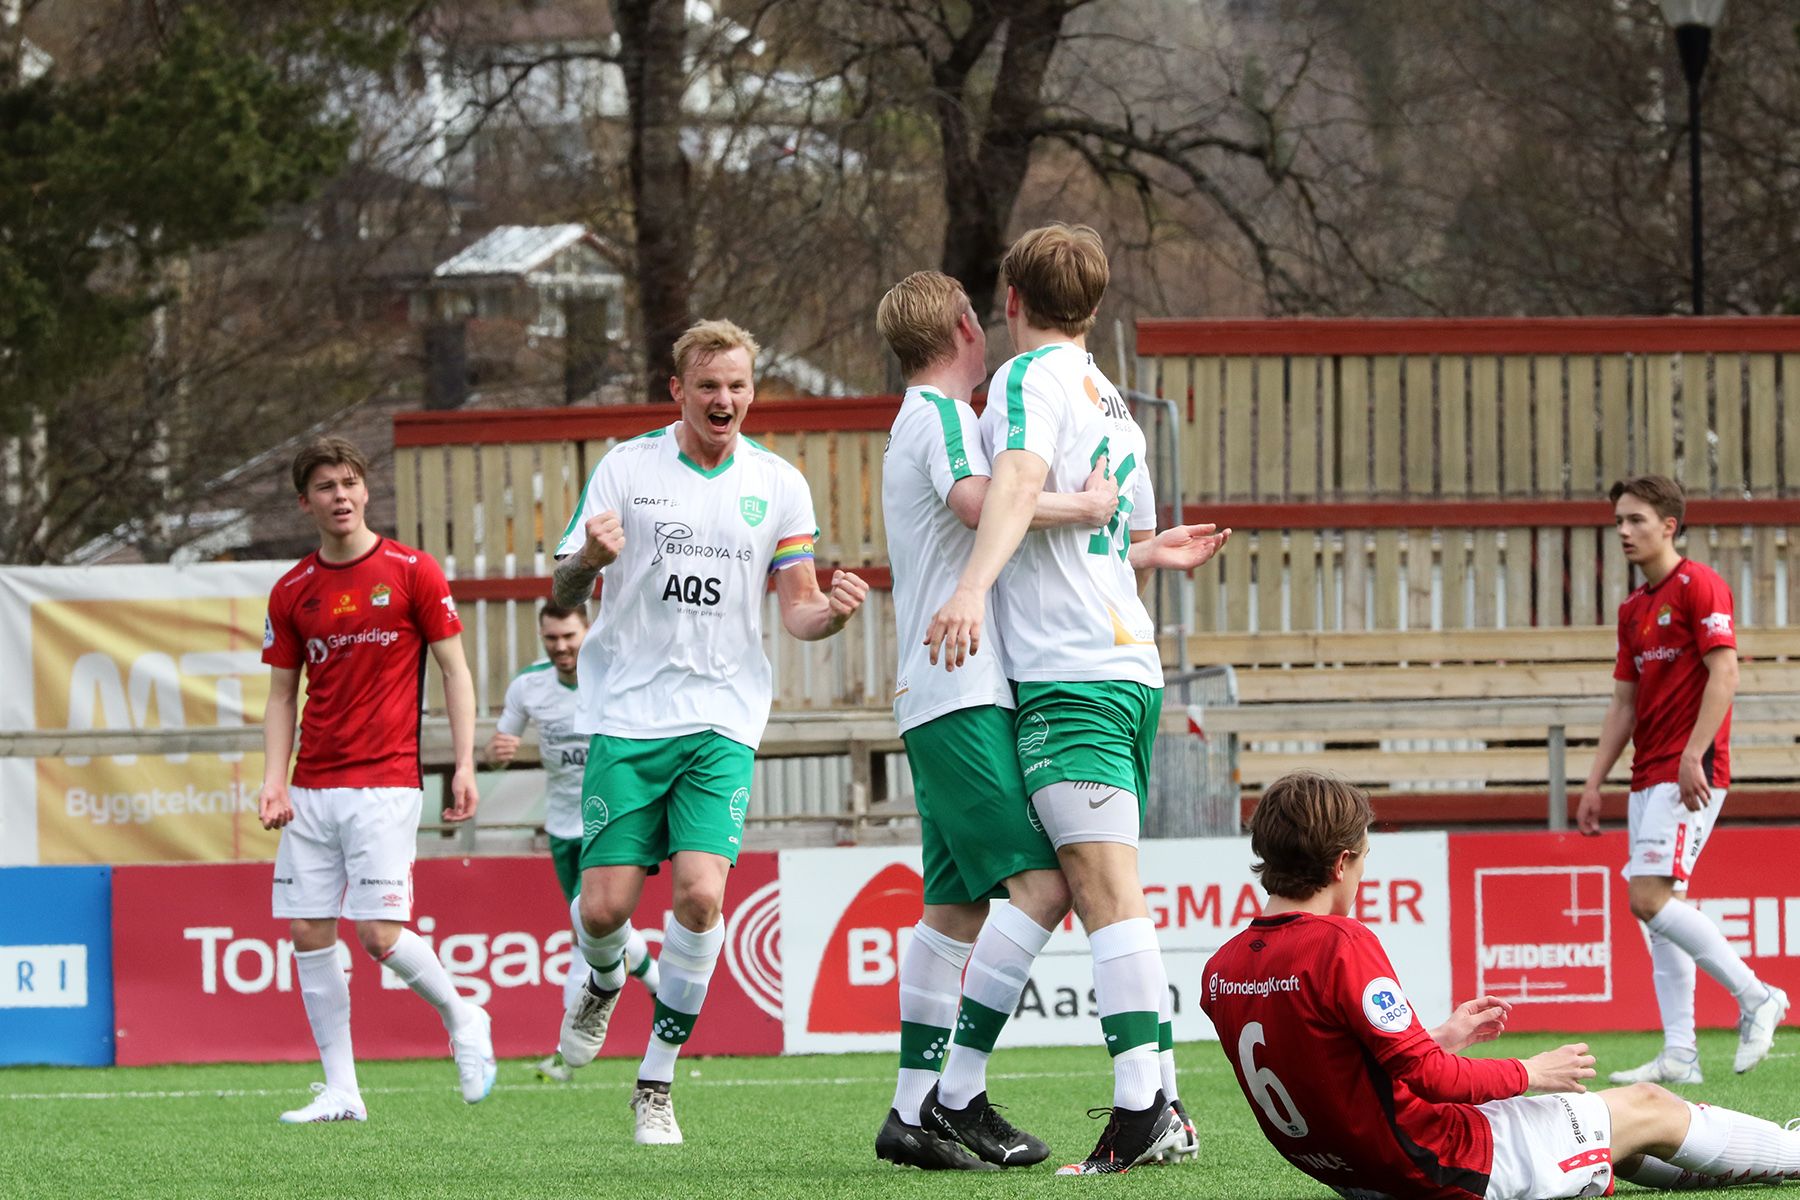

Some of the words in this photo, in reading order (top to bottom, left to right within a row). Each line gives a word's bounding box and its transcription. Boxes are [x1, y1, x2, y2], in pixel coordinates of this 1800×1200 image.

[633, 497, 669, 506] CRAFT
[744, 499, 763, 514] FIL
[665, 542, 731, 560] BJØRØYA
[734, 547, 752, 562] AS
[662, 573, 722, 607] AQS
[561, 748, 589, 768] AQ
[65, 782, 265, 825] Byggteknik
[1480, 942, 1608, 969] VEIDEKKE
[1013, 976, 1181, 1019] Aasn
[1218, 973, 1301, 998] TrøndelagKraft
[1379, 1003, 1409, 1026] OBOS
[1237, 1020, 1309, 1138] 6
[931, 1106, 965, 1145] ULTRA
[1560, 1097, 1581, 1136] BØRSTAD
